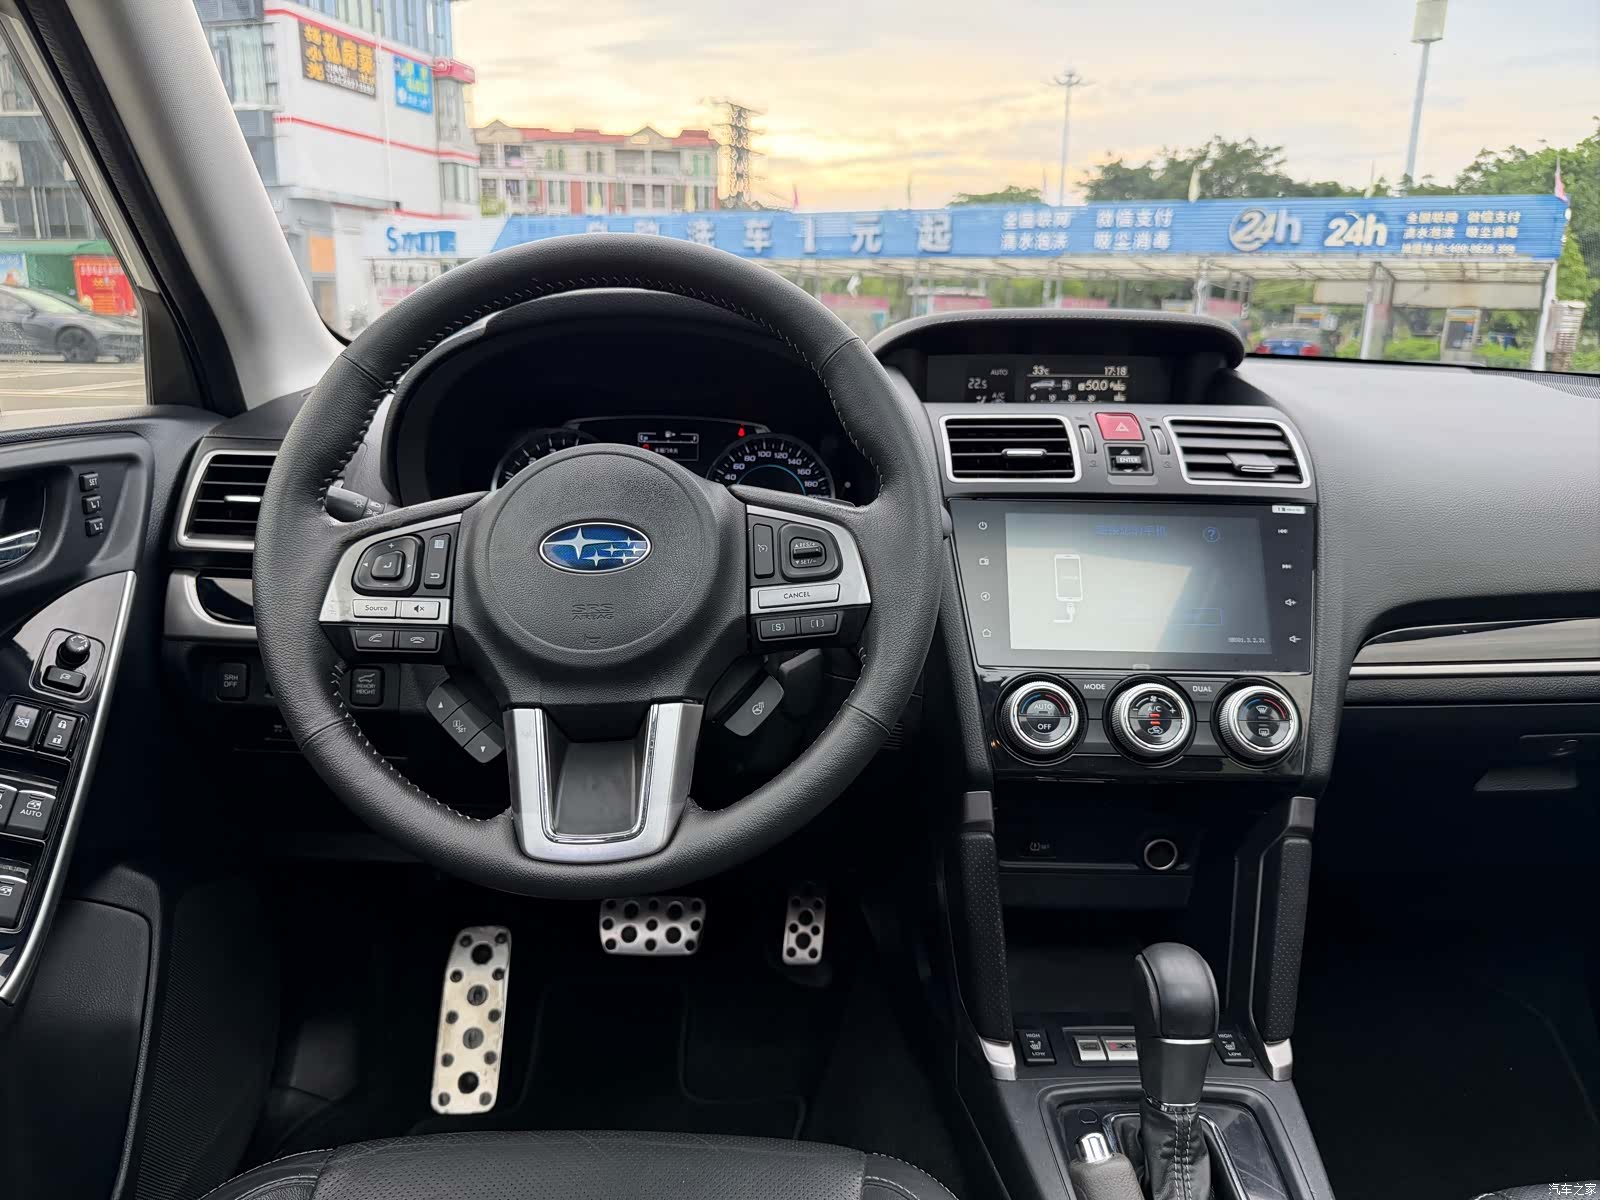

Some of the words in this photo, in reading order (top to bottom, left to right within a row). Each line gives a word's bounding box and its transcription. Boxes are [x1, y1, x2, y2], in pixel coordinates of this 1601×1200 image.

[1095, 208, 1174, 228] 微信支付
[1323, 210, 1388, 247] 24h
[1104, 366, 1128, 376] 17:18
[757, 450, 771, 458] 100
[787, 458, 802, 466] 140
[797, 468, 811, 476] 160
[724, 473, 736, 481] 40
[783, 591, 811, 599] CANCEL
[364, 604, 388, 612] Source
[1083, 683, 1106, 691] MODE
[1192, 685, 1213, 693] DUAL
[1034, 703, 1053, 711] AUTO
[1147, 705, 1161, 713] A/C
[1037, 722, 1052, 731] OFF
[20, 809, 42, 818] AUTO
